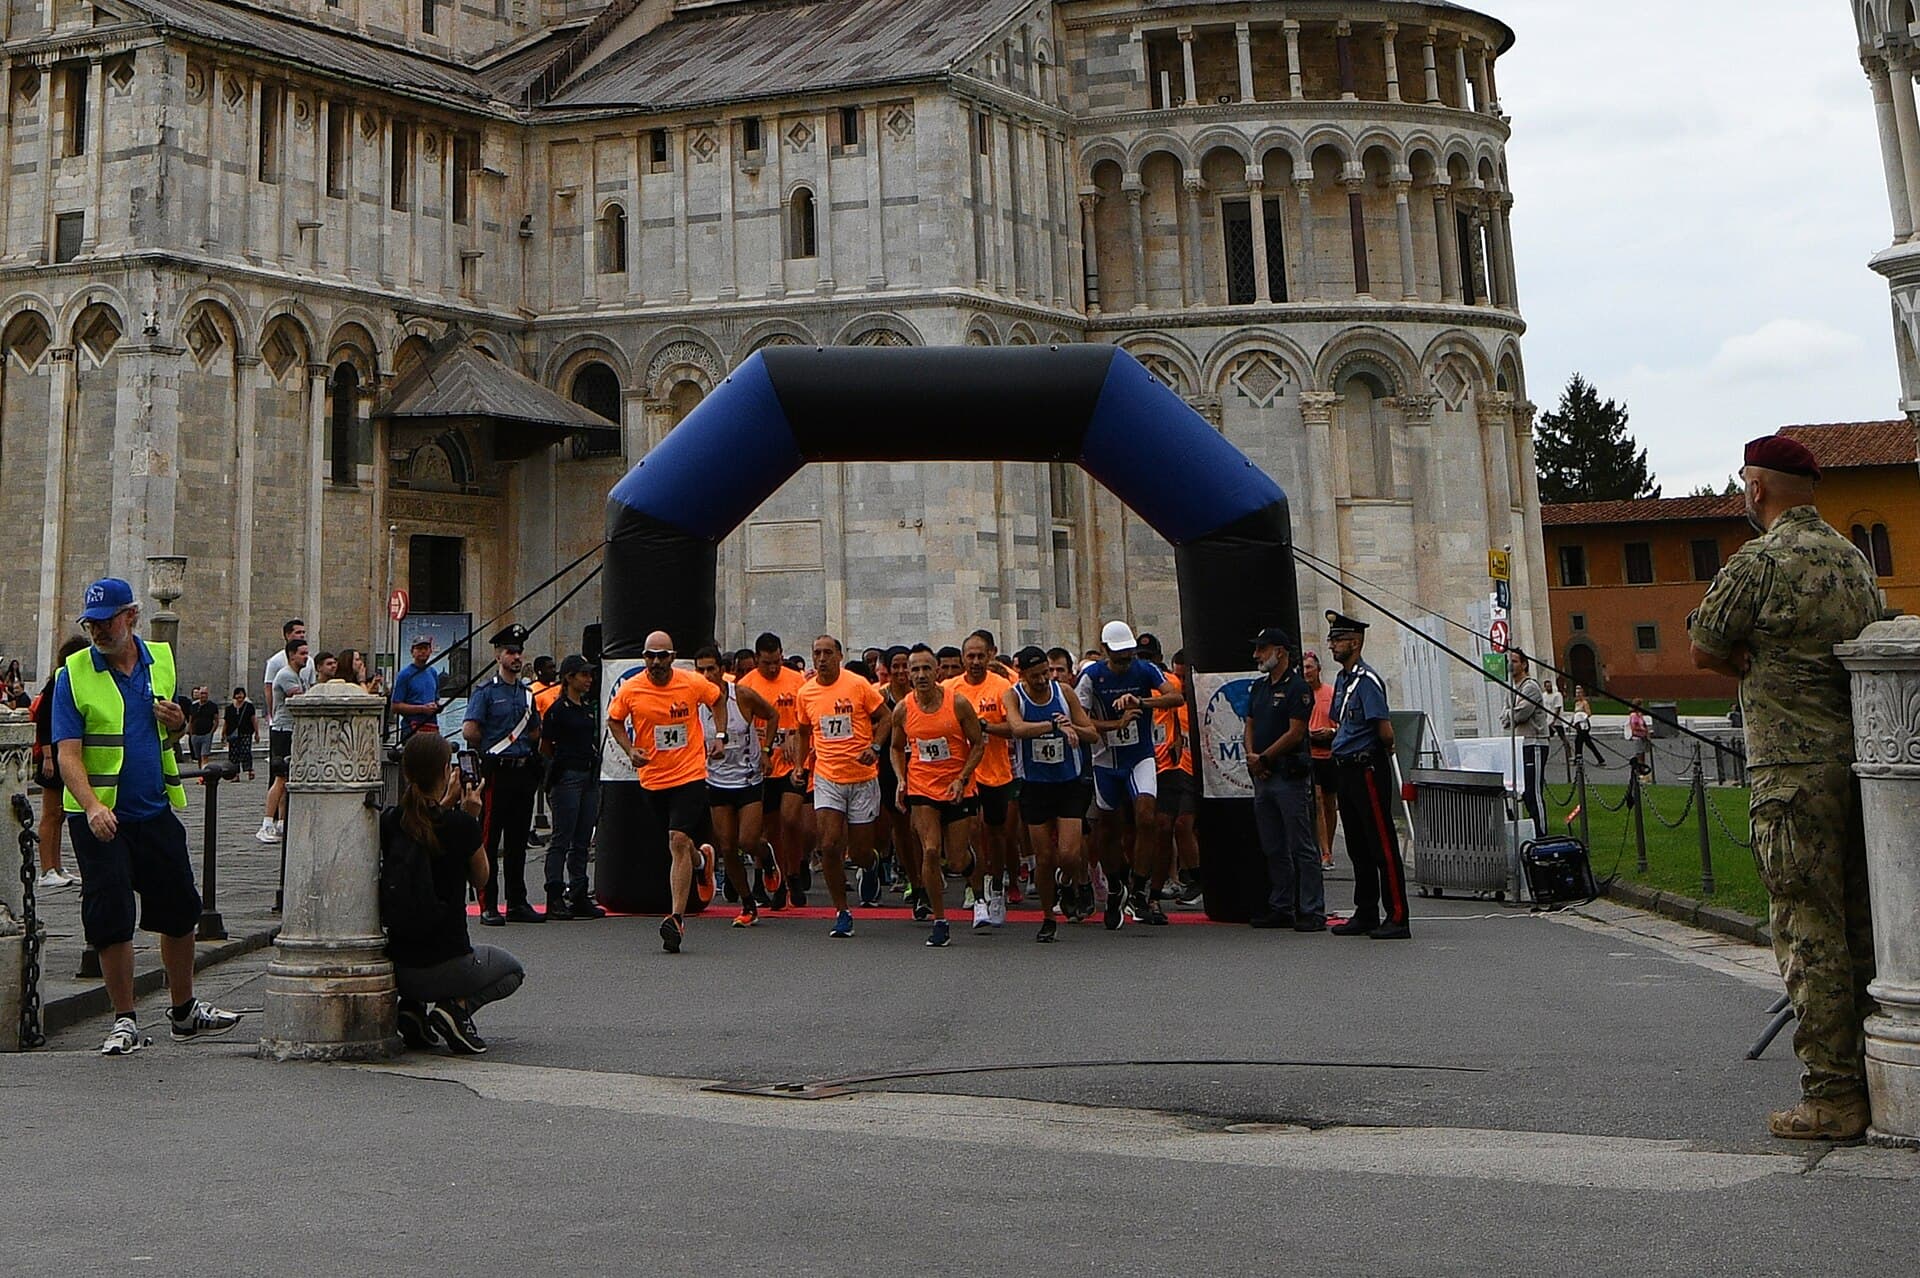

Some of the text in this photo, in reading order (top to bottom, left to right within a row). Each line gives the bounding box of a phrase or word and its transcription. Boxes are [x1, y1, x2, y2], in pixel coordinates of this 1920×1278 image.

[828, 720, 842, 734] 77
[663, 730, 678, 744] 34
[1116, 728, 1130, 740] 48
[1042, 745, 1056, 758] 46
